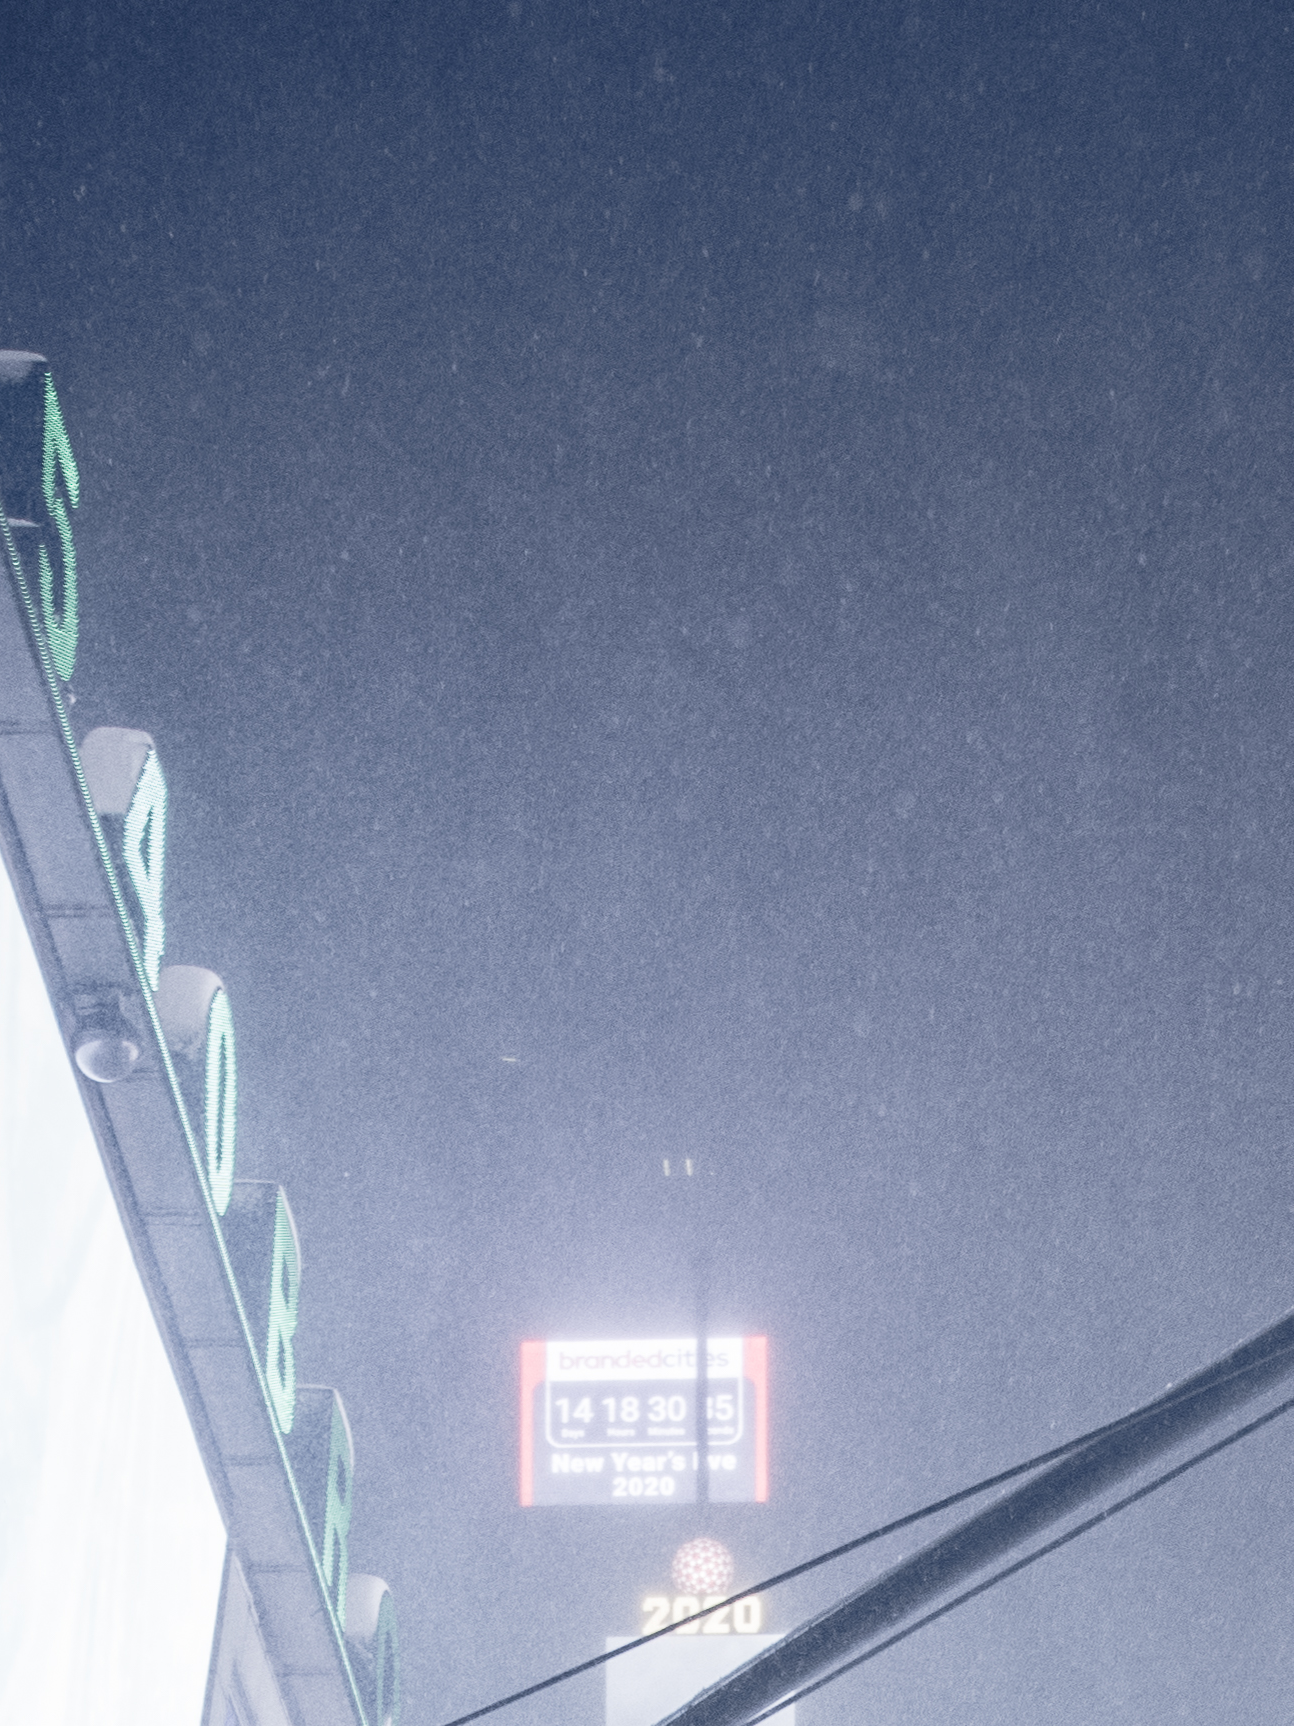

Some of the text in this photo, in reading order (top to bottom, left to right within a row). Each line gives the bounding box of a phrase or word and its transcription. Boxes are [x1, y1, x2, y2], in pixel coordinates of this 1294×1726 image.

[559, 1347, 729, 1370] brandedcites
[555, 1396, 594, 1424] 14
[602, 1396, 640, 1423] 18
[647, 1395, 687, 1422] 30
[551, 1453, 604, 1473] New
[611, 1451, 687, 1472] Year's
[612, 1475, 676, 1497] 2020
[642, 1596, 762, 1637] 2020
